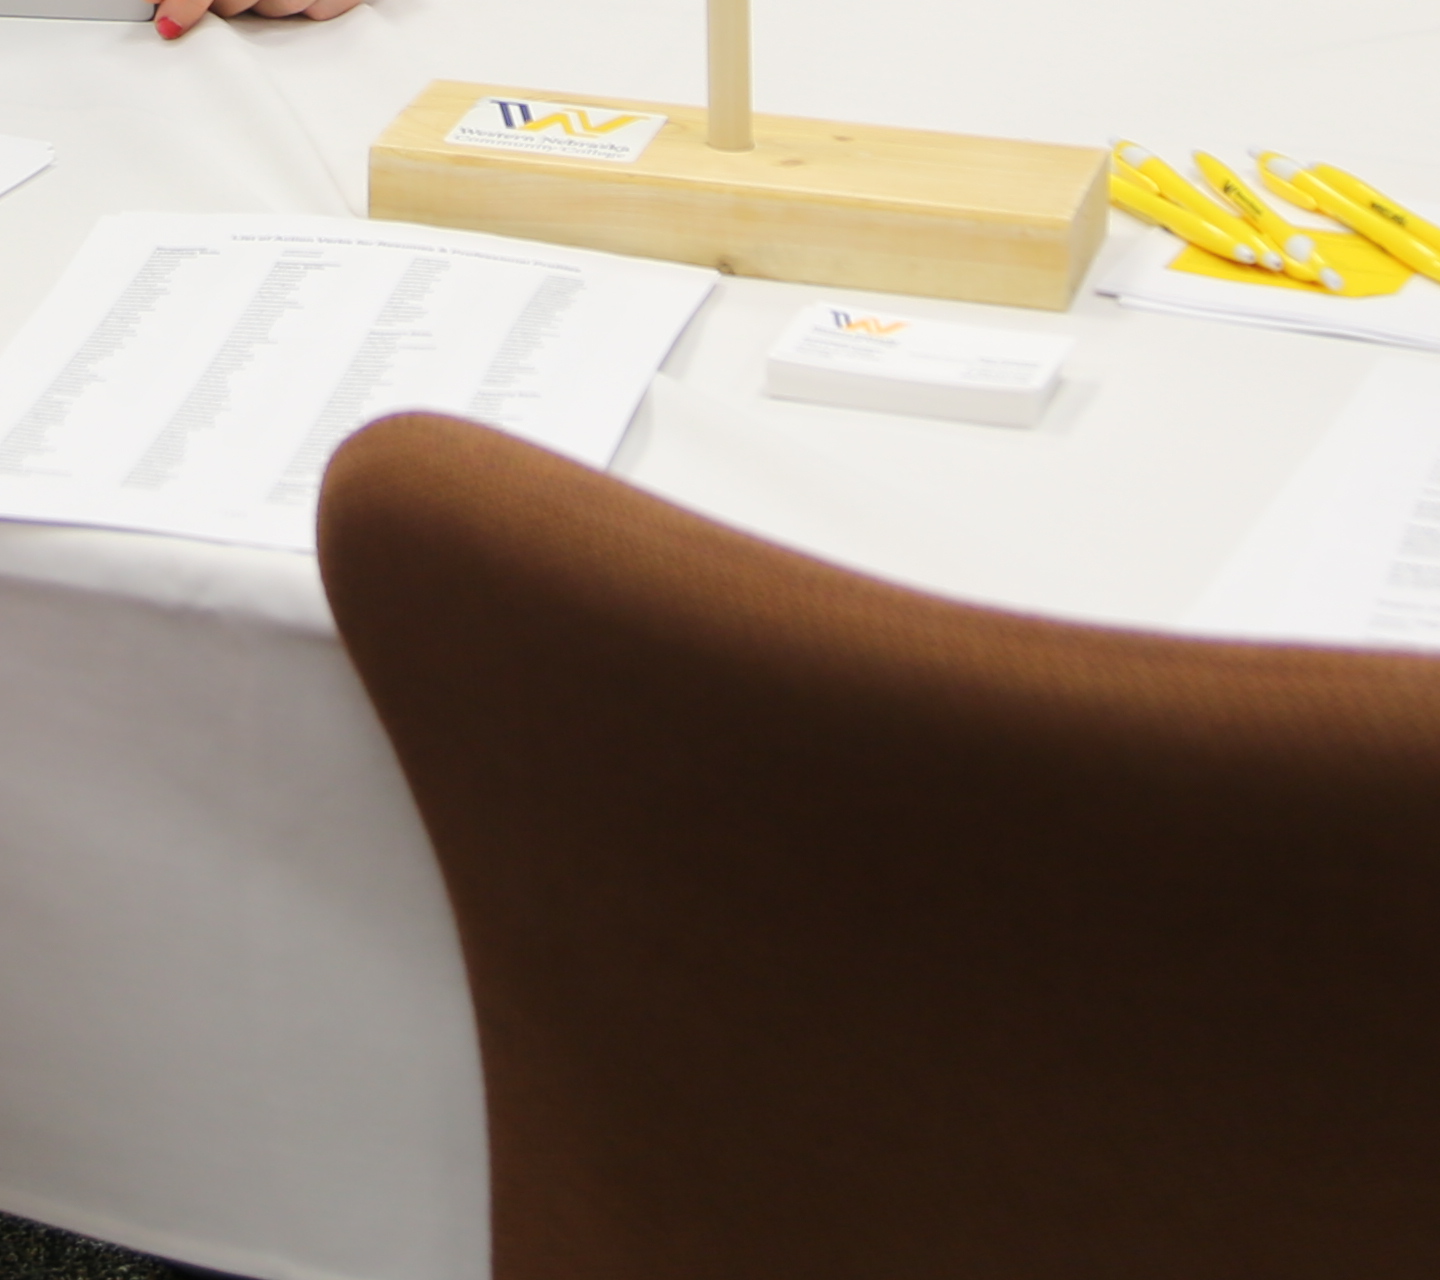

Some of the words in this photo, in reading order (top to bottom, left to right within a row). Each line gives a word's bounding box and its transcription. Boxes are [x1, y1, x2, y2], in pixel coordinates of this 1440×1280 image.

[454, 135, 557, 151] Community
[561, 144, 626, 158] College
[458, 126, 535, 142] Western
[542, 136, 630, 152] Nebraska
